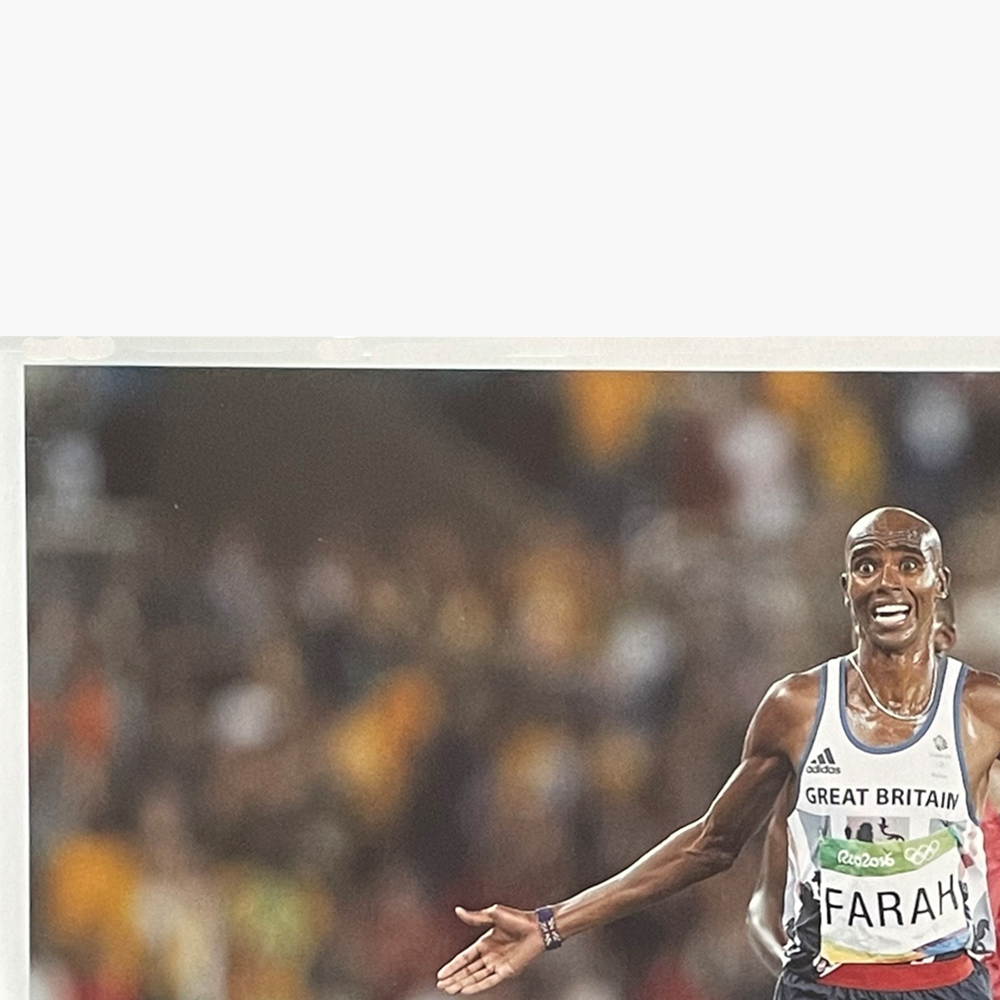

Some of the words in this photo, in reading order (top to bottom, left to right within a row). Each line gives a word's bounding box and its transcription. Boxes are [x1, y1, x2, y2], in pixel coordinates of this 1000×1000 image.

[806, 765, 841, 775] adidas
[805, 787, 869, 806] GREAT
[876, 788, 960, 810] BRITAIN
[825, 874, 959, 928] FARAH
